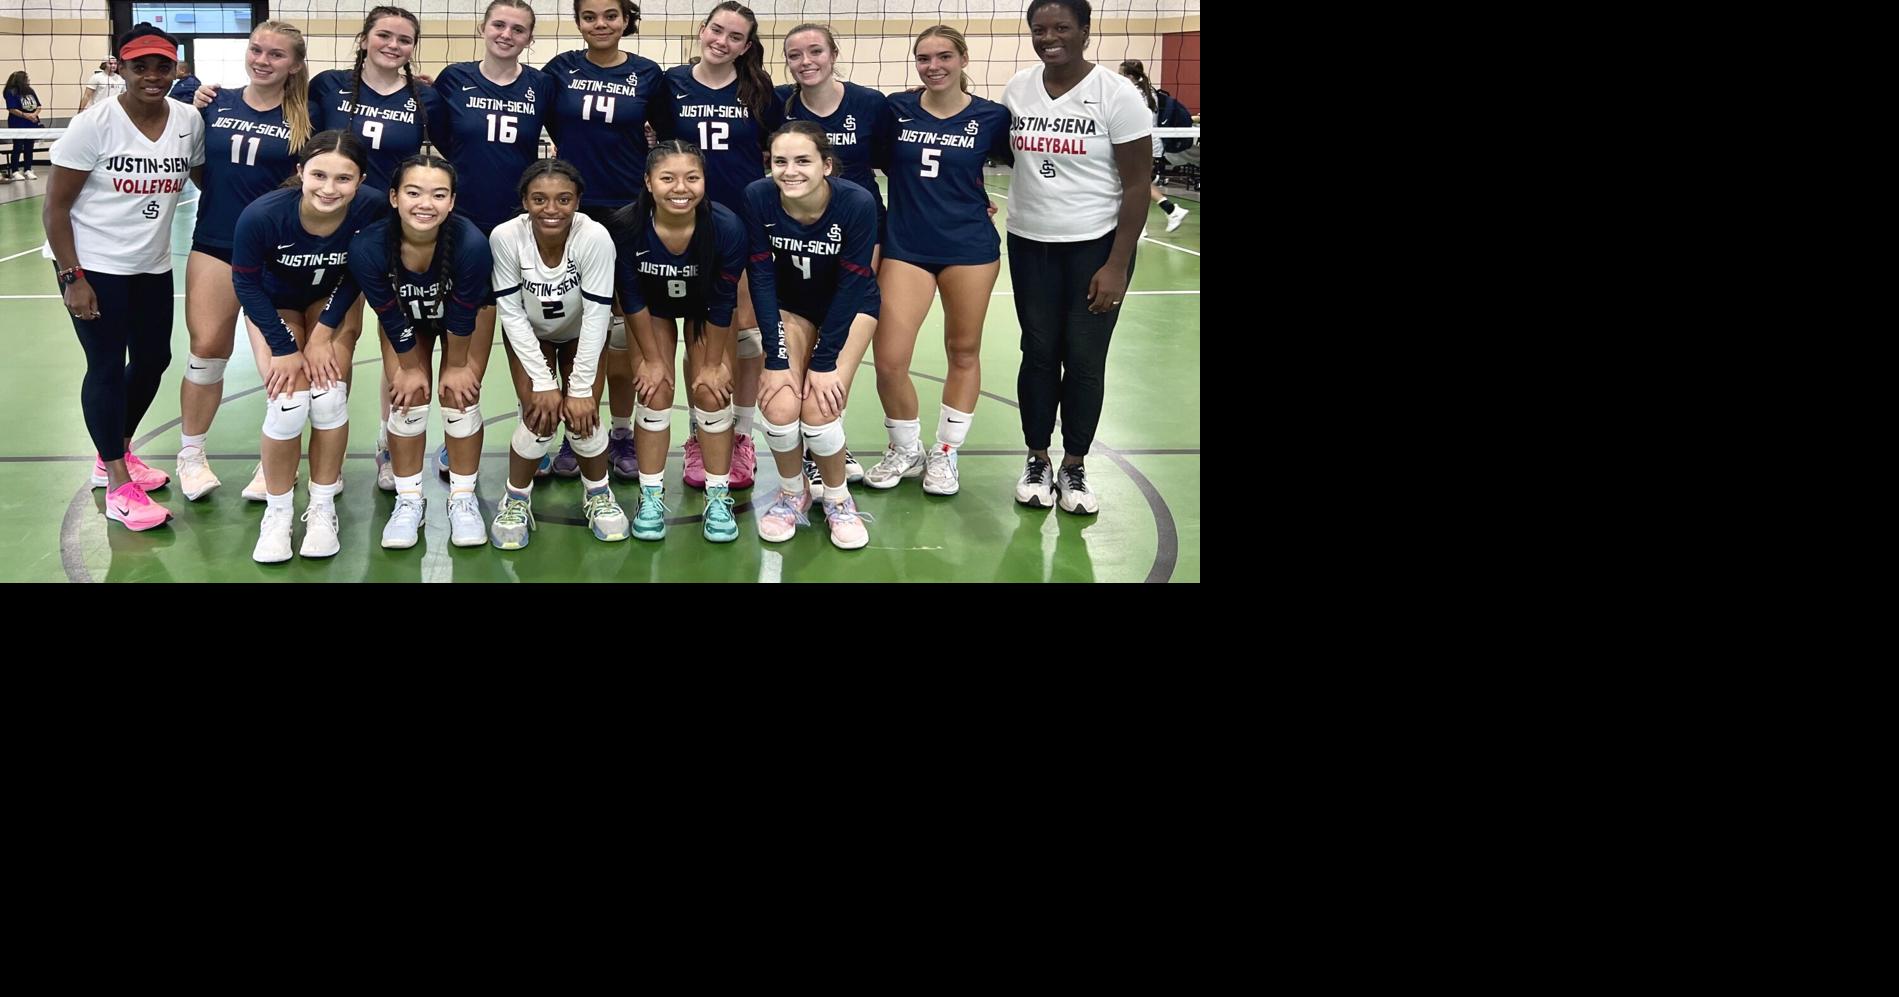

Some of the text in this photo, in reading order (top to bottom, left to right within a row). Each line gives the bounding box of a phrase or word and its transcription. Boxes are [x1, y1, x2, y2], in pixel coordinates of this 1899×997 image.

[568, 79, 636, 97] JUSTIN-SIENA
[466, 96, 536, 115] JUSTIN-SIENA
[582, 94, 615, 124] 14
[362, 120, 384, 150] 9
[486, 113, 518, 144] 16
[697, 121, 730, 150] 12
[898, 129, 975, 149] JUSTIN-SIENA
[1010, 135, 1087, 155] VOLLEYBALL
[230, 133, 261, 167] 11
[106, 155, 190, 174] JUSTIN-SIEN
[920, 147, 942, 179] 5
[311, 268, 326, 286] 1
[791, 254, 811, 281] 4
[667, 279, 687, 298] 8
[541, 300, 566, 320] 2
